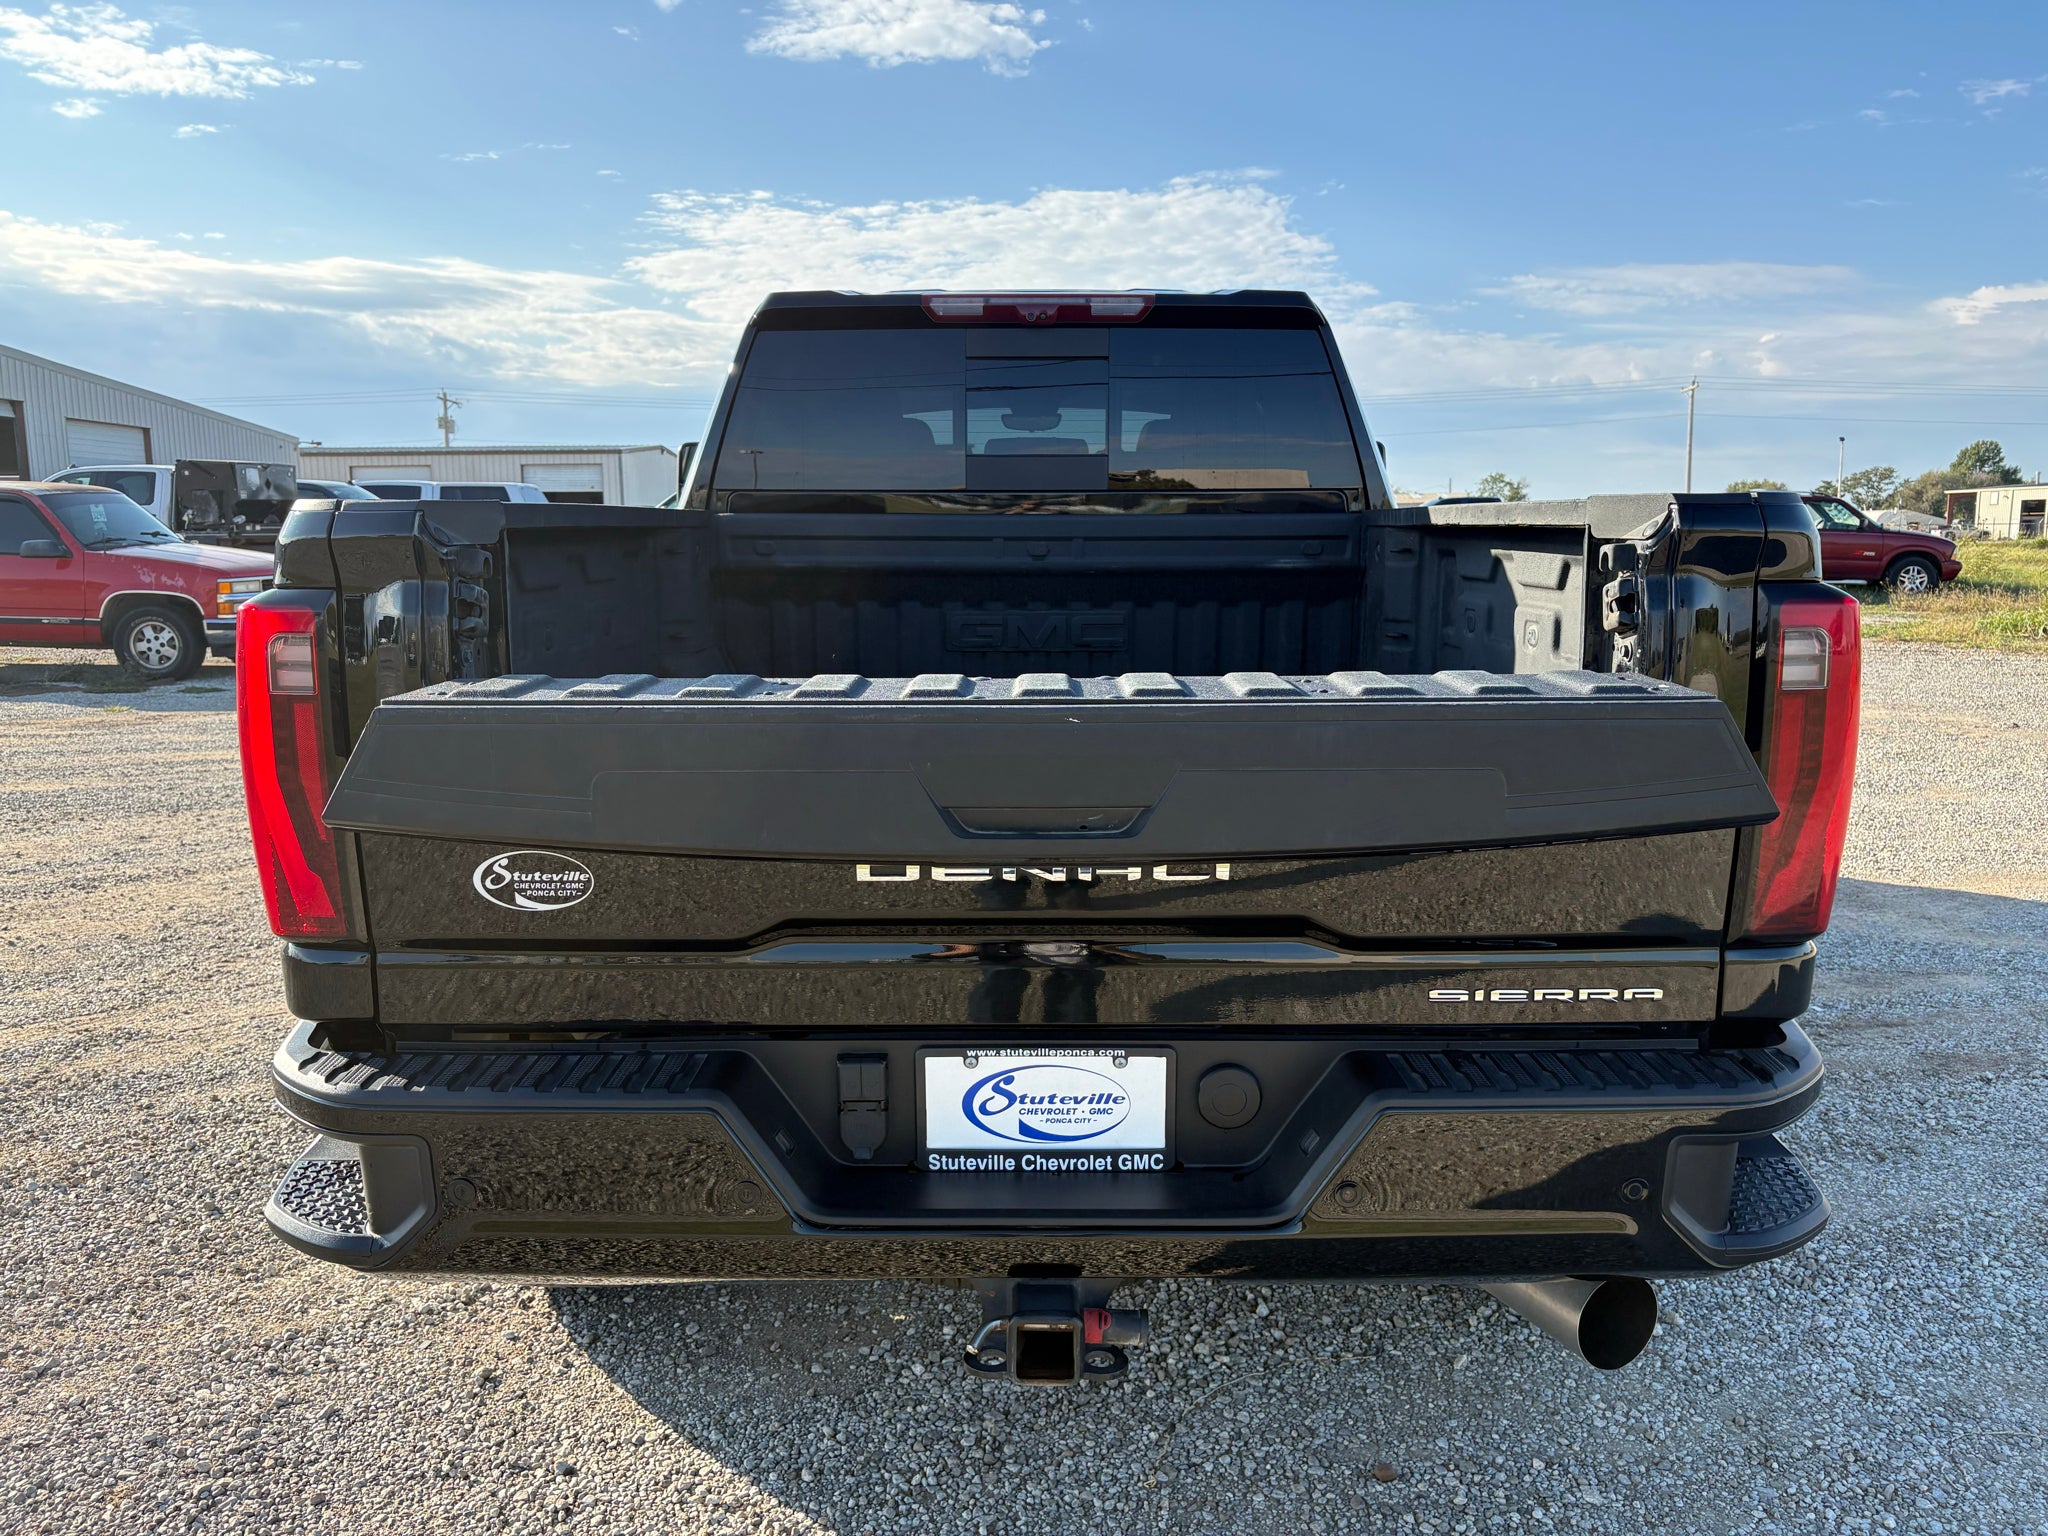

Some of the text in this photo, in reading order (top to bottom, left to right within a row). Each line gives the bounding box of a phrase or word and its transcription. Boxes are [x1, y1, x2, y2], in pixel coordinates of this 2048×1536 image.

[951, 614, 1127, 648] GMC
[485, 857, 590, 889] Stuteville
[1428, 988, 1664, 1003] SIERRA
[966, 1048, 1126, 1057] www.stutevilleponca.com
[978, 1074, 1126, 1116] Stuteville
[1018, 1107, 1114, 1116] CHEVROLET GMC
[928, 1153, 1165, 1171] Stuteville Chevrolet GMC
